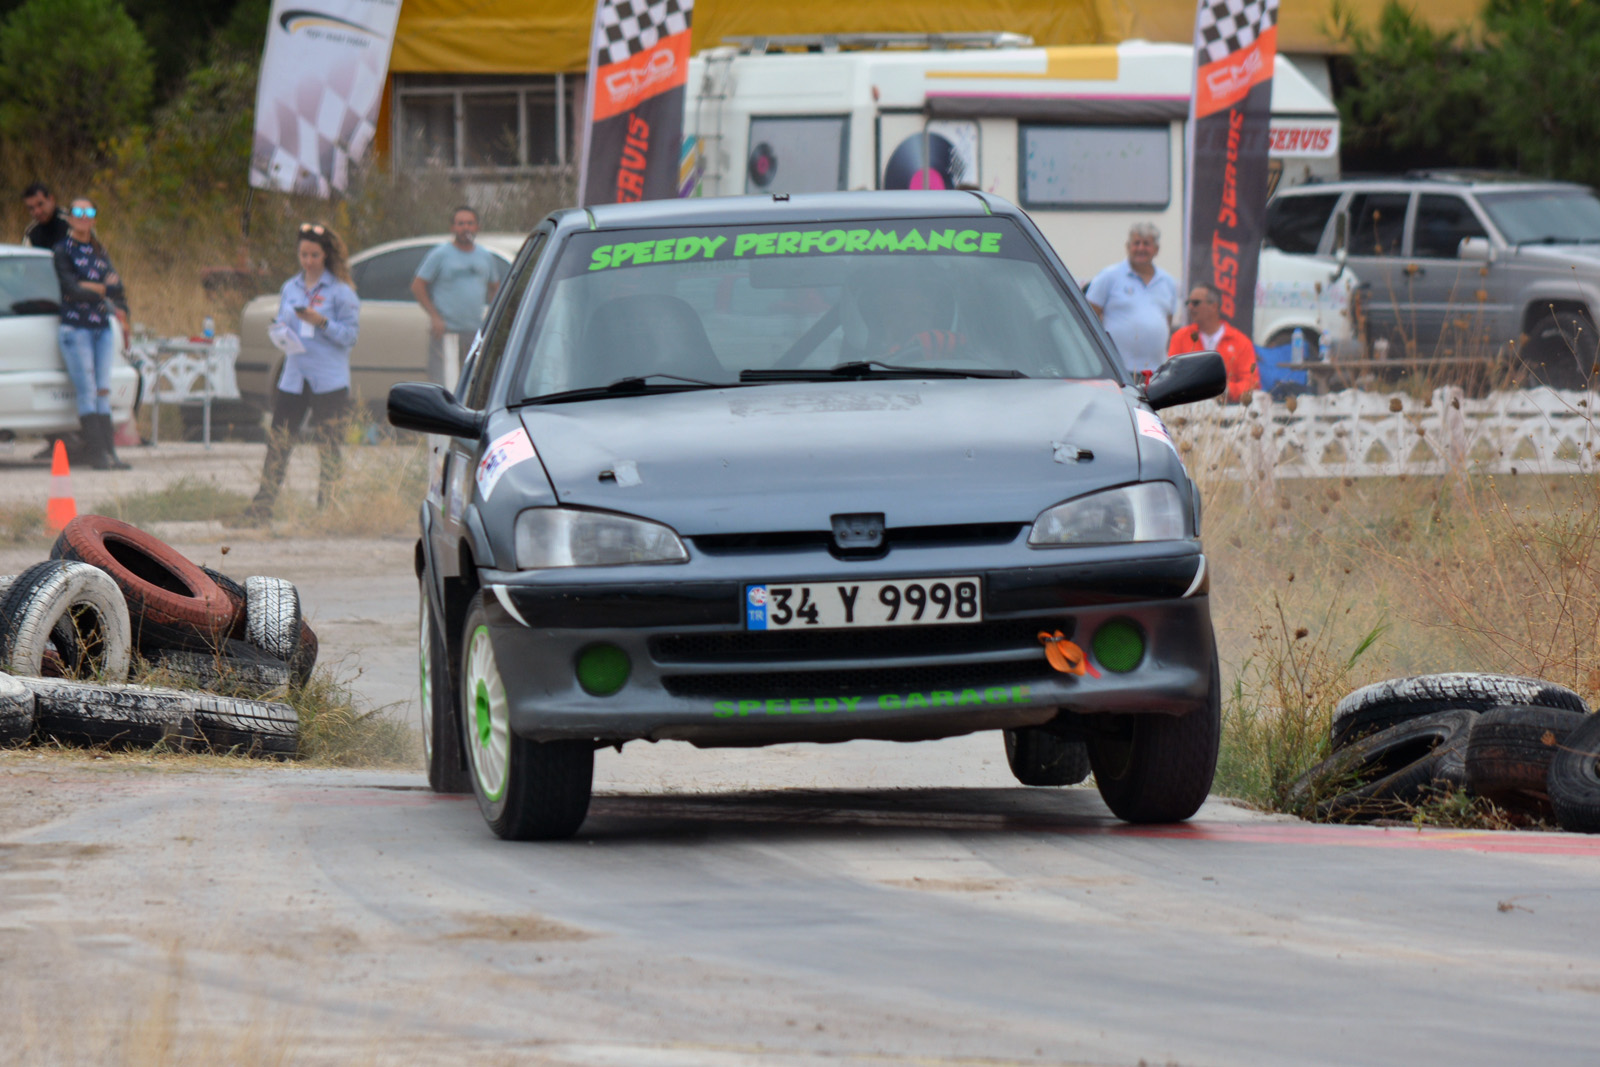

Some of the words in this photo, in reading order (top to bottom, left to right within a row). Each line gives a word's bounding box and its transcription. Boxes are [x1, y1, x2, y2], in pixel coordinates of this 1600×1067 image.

[588, 234, 728, 270] SPEEDY
[733, 228, 1002, 256] PERFORMANCE
[748, 609, 765, 621] TR
[769, 587, 819, 626] 34
[837, 585, 860, 623] Y
[878, 581, 978, 622] 9998
[713, 696, 862, 718] SPEEDY
[877, 685, 1032, 710] GARAGE
